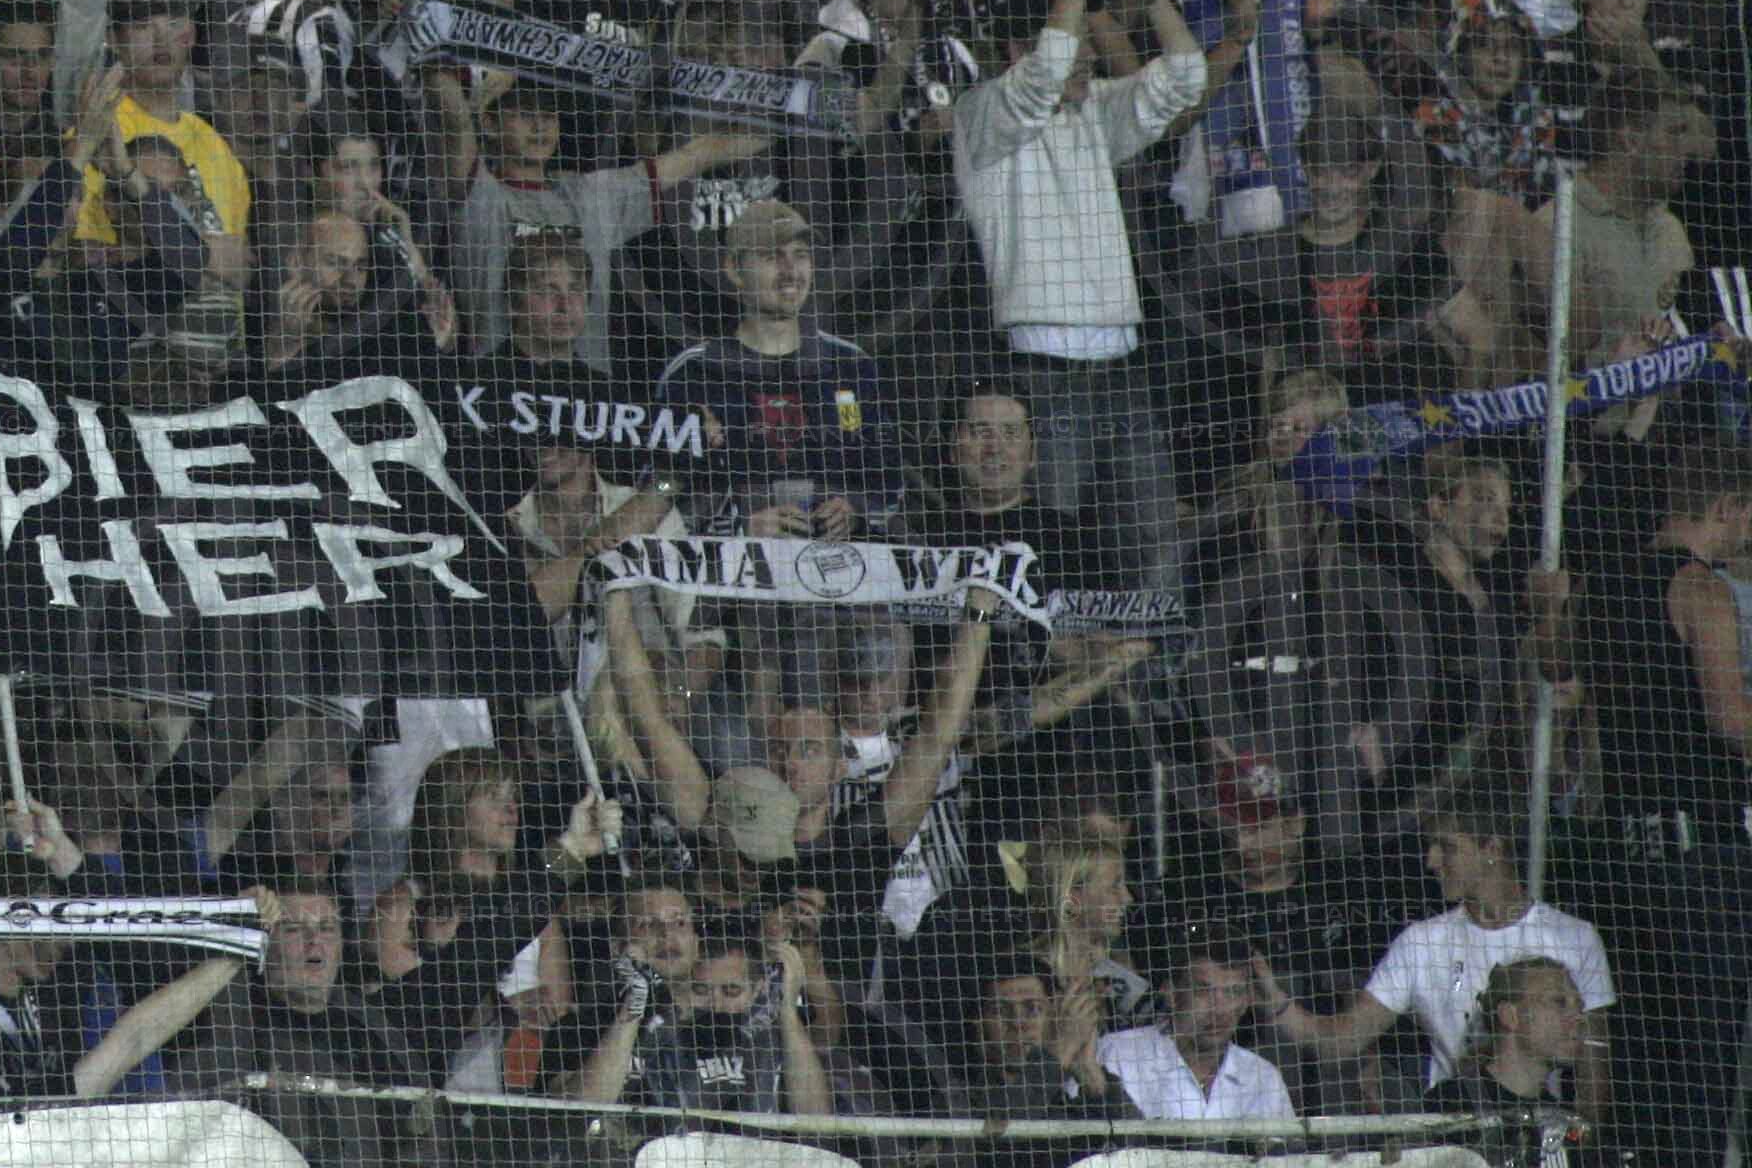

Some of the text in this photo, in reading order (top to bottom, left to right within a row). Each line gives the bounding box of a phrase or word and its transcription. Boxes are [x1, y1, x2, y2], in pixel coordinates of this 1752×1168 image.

[671, 61, 727, 102] GRA
[453, 385, 704, 458] K STURM
[1451, 378, 1548, 429] Sturm
[35, 519, 488, 617] HER
